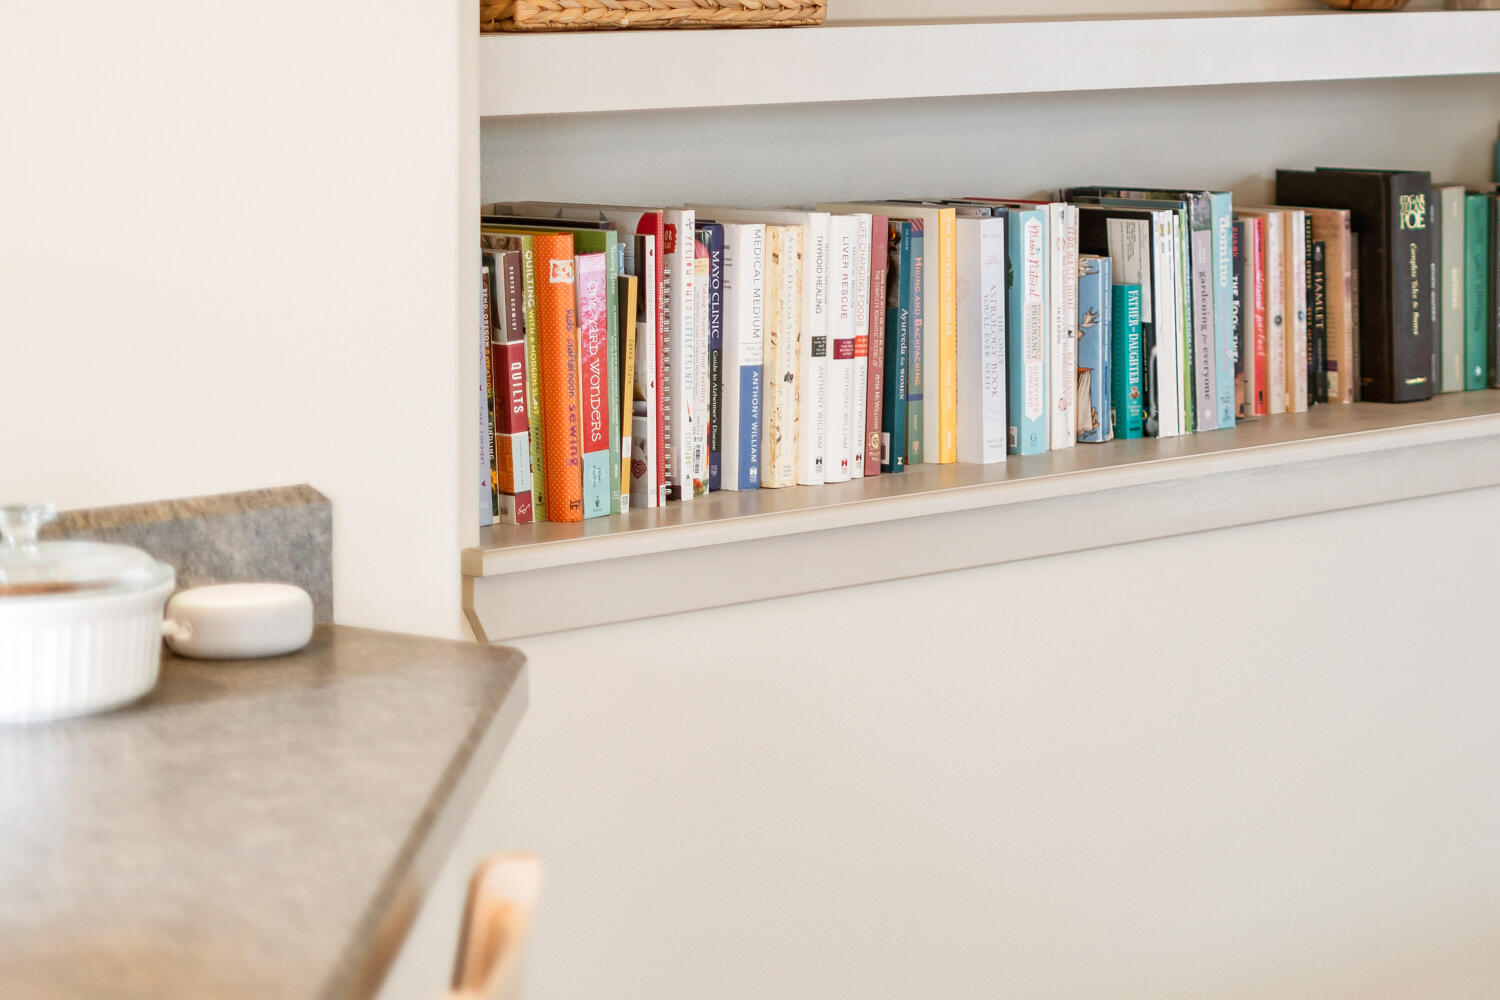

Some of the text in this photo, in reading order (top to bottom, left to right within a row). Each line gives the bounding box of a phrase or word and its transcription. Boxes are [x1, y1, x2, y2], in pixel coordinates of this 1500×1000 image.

[1399, 209, 1427, 230] POE
[753, 229, 762, 286] MEDICAL
[815, 234, 824, 315] THYROID HEALING
[858, 221, 867, 292] LIFE-CHANGING
[914, 257, 923, 293] HIKING
[1027, 224, 1041, 298] Mama Natural
[1218, 214, 1231, 288] domino
[1408, 242, 1419, 278] Complete
[711, 250, 720, 340] MAYO CLINIC
[752, 287, 761, 339] MEDIUM
[841, 273, 849, 320] RESCUE
[856, 294, 865, 328] FOODS
[1314, 271, 1324, 329] HAMLET
[1411, 280, 1419, 299] Tales
[524, 249, 540, 416] QUILTING WITH A MODERN SLANT
[899, 308, 909, 355] Ayurveda
[983, 332, 991, 357] EVER
[989, 284, 999, 398] ASTROLOGY BOOK
[1031, 304, 1039, 360] PREGNANCY
[1128, 289, 1140, 385] FATHER DAUGHTER
[1198, 271, 1211, 401] gardening for everyone
[510, 361, 524, 415] QUILTS
[566, 309, 579, 468] kids crafternoon sewing
[712, 373, 718, 381] to
[751, 370, 760, 419] ANTHONY
[750, 423, 759, 464] WILLIAM
[816, 412, 824, 449] WILLIAM
